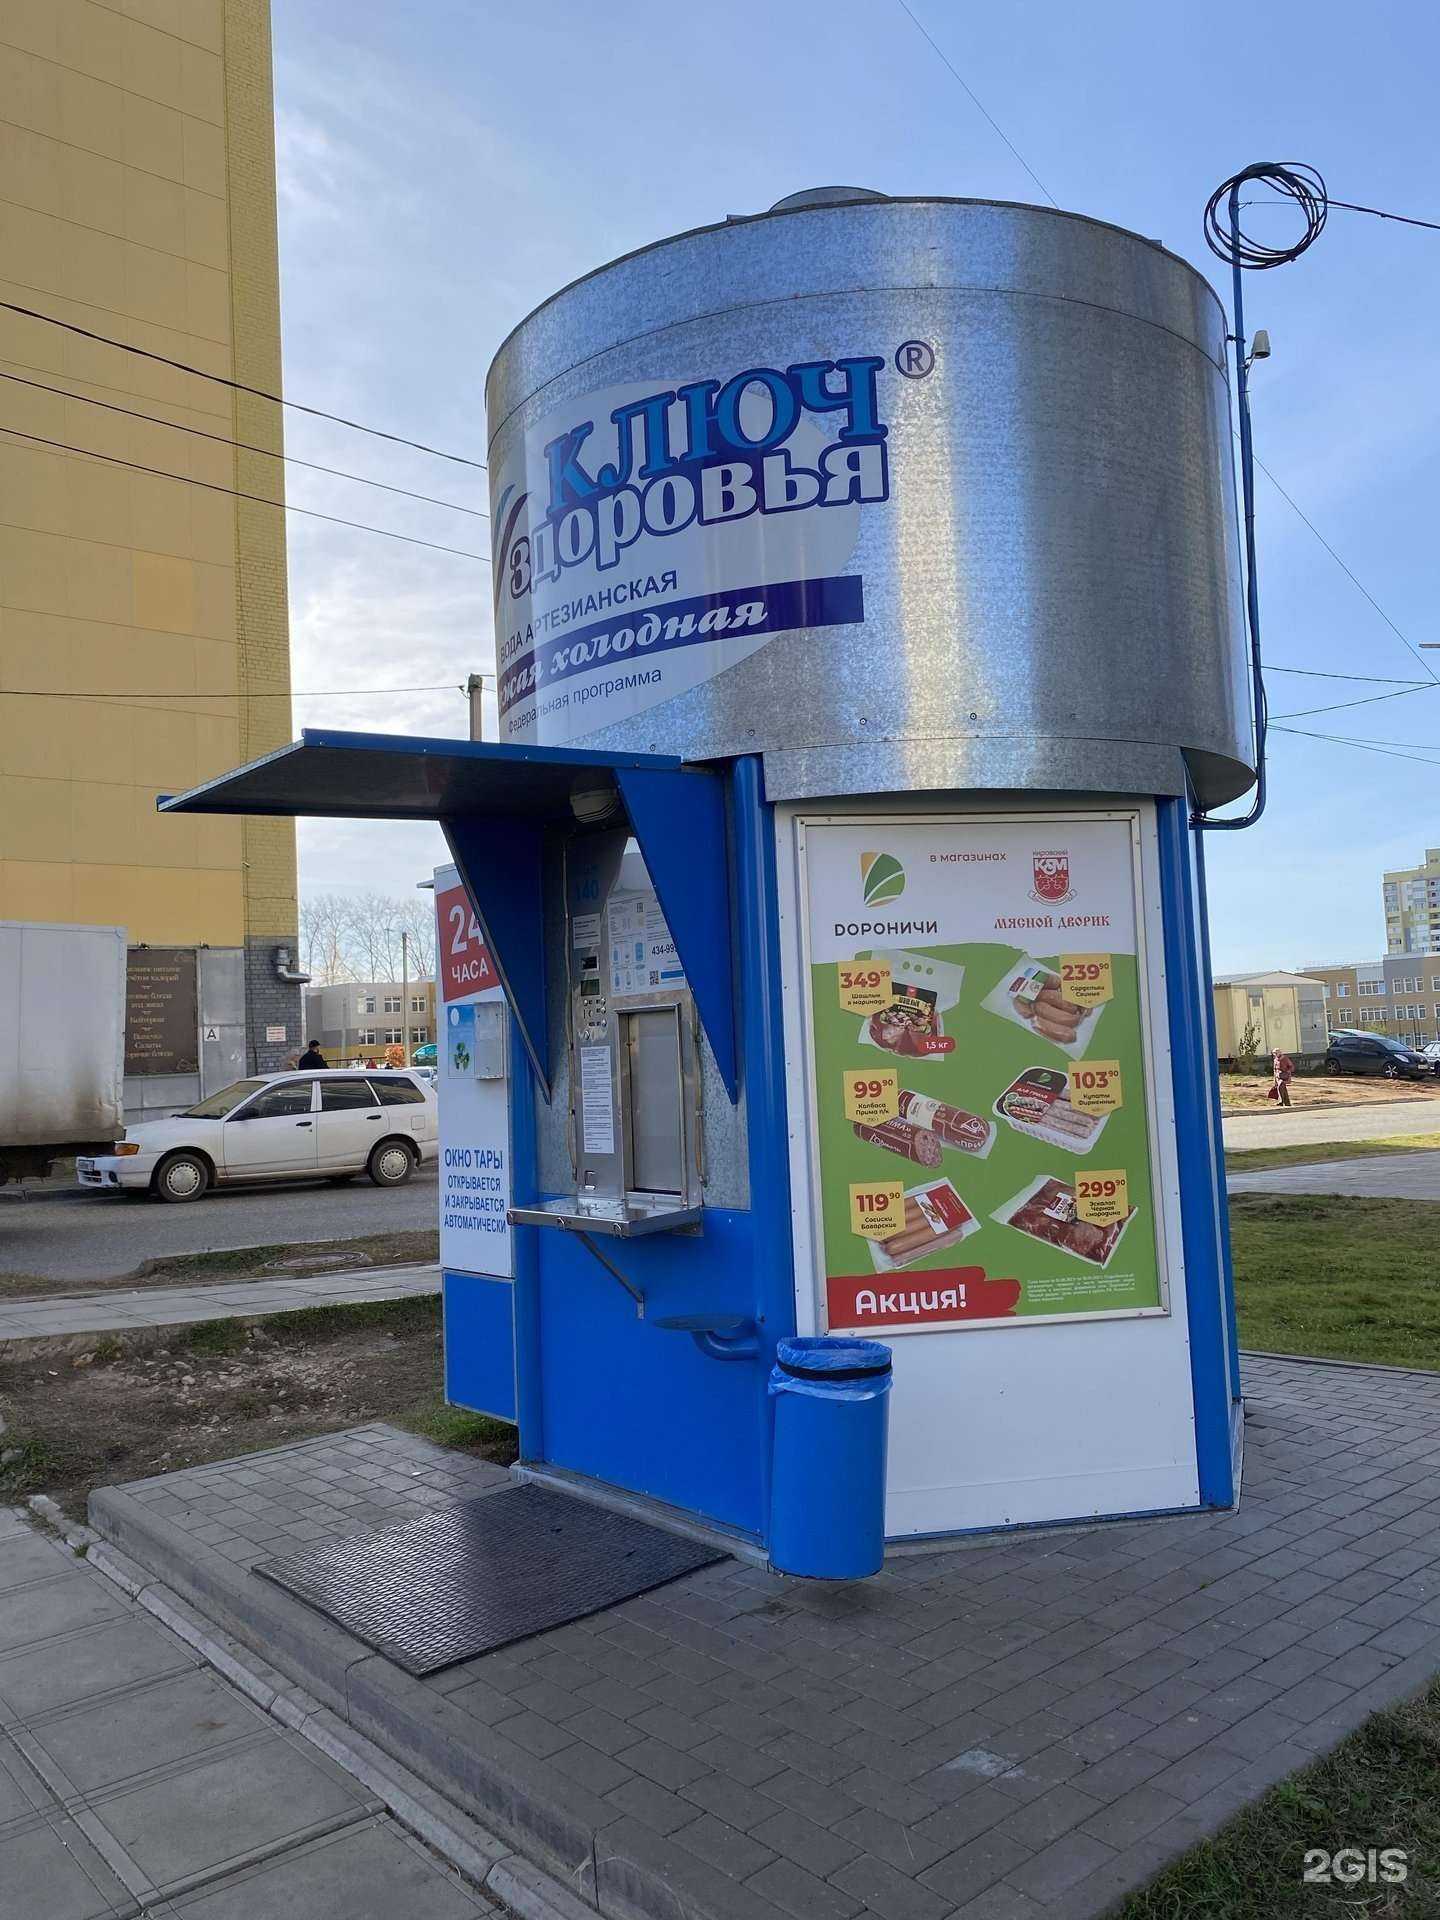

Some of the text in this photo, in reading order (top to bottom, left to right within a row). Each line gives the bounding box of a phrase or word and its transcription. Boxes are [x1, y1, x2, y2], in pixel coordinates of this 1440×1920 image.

[544, 356, 888, 513] КЛЮЧ
[525, 570, 677, 644] АРТЕЗИАНСКАЯ
[551, 601, 768, 675] холодная
[573, 669, 662, 705] программа
[929, 851, 1007, 863] в магазинах
[450, 904, 485, 955] 24
[994, 915, 1110, 929] МЯСНОЙ ДВОРИК
[652, 943, 677, 955] 434-99
[451, 958, 490, 984] ЧАСА
[444, 1148, 503, 1170] ОКНО ТАРЫ
[447, 1174, 501, 1192] ОТКРЫВАЕТСЯ
[444, 1193, 505, 1213] И ЗАКРЫВАЕТСЯ
[444, 1213, 507, 1234] АВТОМАТИЧЕСКИ
[854, 1283, 967, 1315] Акция!
